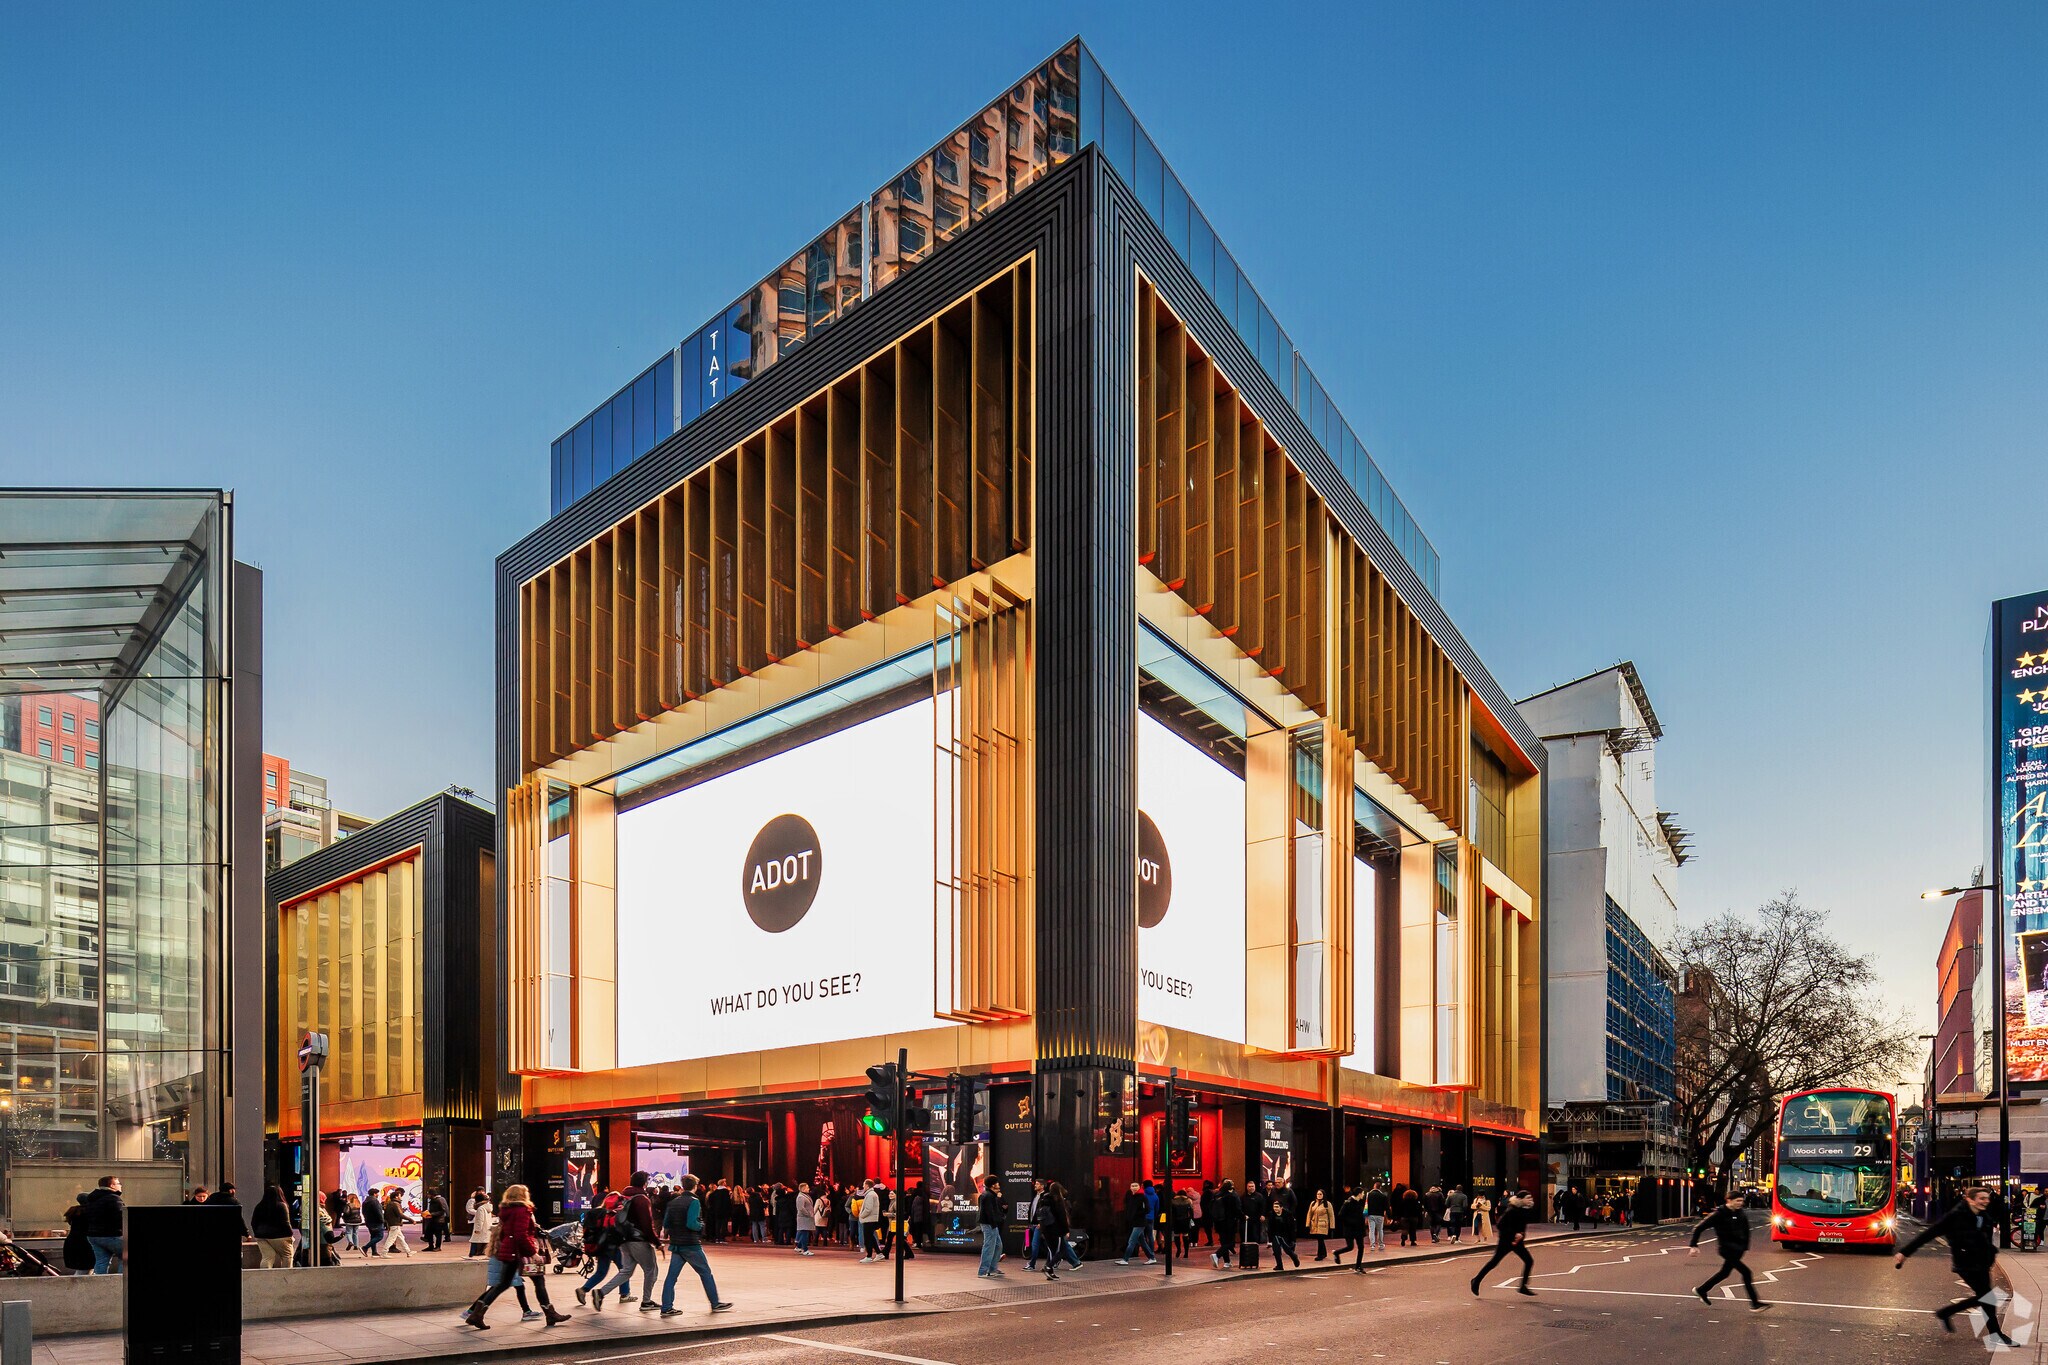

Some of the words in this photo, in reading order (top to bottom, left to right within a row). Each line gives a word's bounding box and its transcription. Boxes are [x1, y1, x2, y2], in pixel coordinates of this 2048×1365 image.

[709, 330, 720, 408] TAT
[750, 850, 813, 894] ADOT
[2012, 899, 2038, 909] AND
[1141, 968, 1163, 991] YOU
[1166, 976, 1193, 999] SEE?
[711, 992, 752, 1016] WHAT
[757, 988, 778, 1008] DO
[782, 981, 814, 1004] YOU
[819, 972, 862, 998] SEE?
[1265, 1121, 1275, 1130] THE
[1271, 1131, 1281, 1139] NOW
[1264, 1140, 1289, 1149] BUILDING
[570, 1150, 595, 1158] BUILDING
[1853, 1145, 1872, 1157] 29
[407, 1162, 420, 1180] 2
